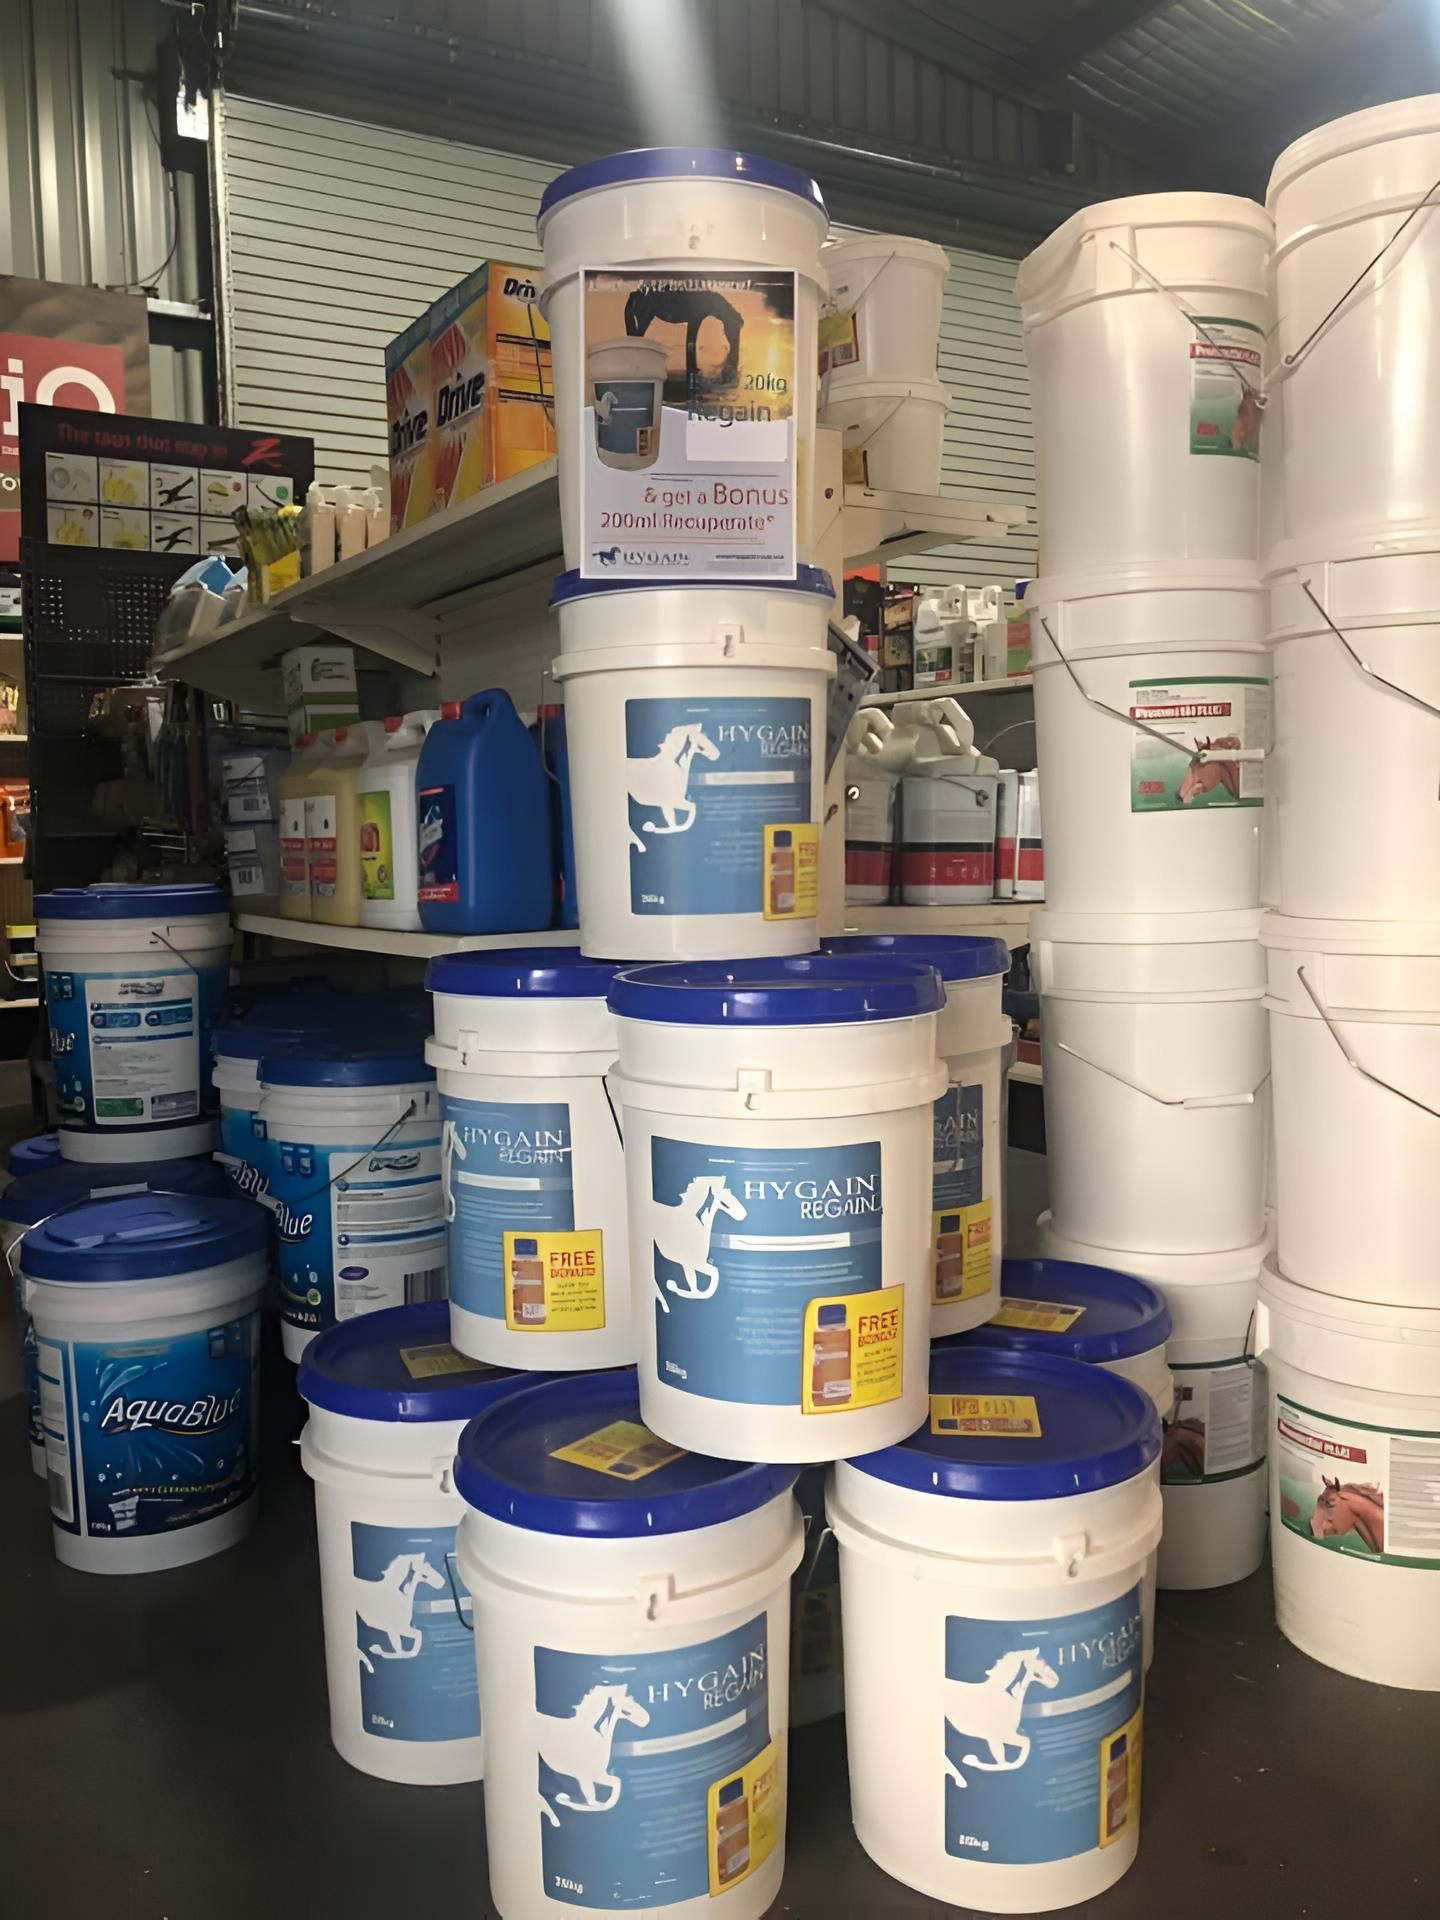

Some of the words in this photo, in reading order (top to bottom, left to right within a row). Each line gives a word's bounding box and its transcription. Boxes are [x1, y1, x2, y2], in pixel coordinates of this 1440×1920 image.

[437, 371, 486, 428] Drive
[713, 482, 789, 506] Bonus
[600, 512, 657, 529] 200ml
[717, 723, 809, 743] HYGAIN
[463, 1126, 564, 1147] HYGAIN
[743, 1174, 881, 1201] HYGAIN
[550, 1250, 596, 1267] FREE
[857, 1307, 899, 1335] FREE
[647, 1642, 765, 1704] HYGAIN
